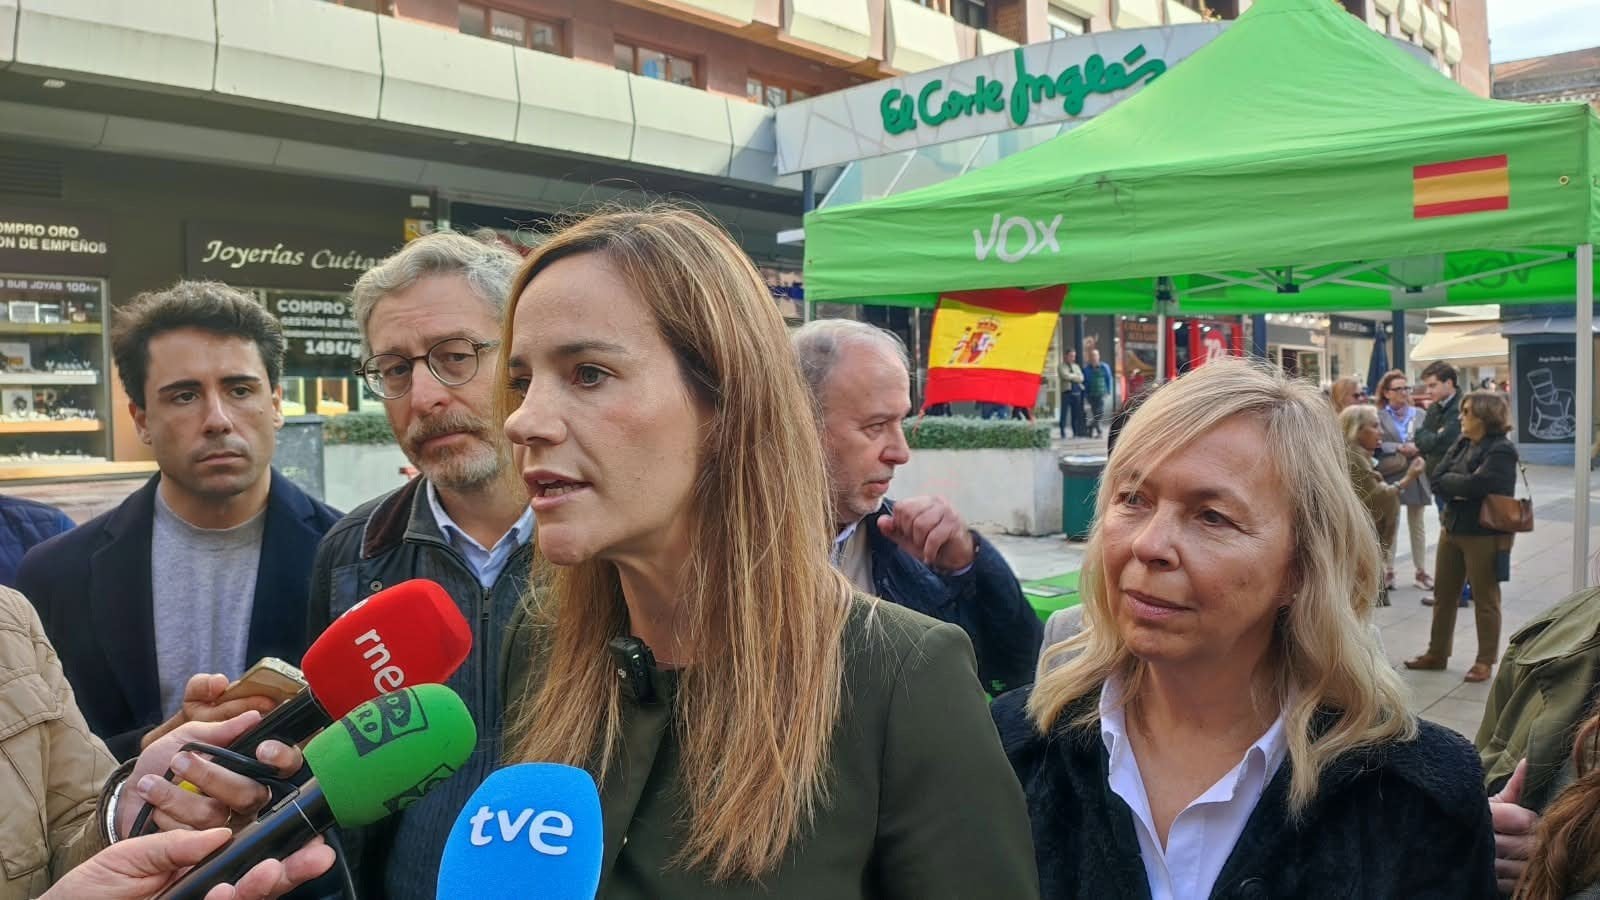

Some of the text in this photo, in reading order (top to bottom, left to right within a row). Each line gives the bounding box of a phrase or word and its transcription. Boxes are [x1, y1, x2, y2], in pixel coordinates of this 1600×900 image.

[880, 44, 1167, 135] El Corte Inglés
[0, 222, 79, 239] OMPRO ORO
[19, 237, 38, 250] DE
[41, 238, 107, 254] EMPEÑOS
[202, 239, 304, 269] Joyerías
[276, 299, 345, 315] COMPRO
[354, 628, 405, 695] rne
[470, 805, 574, 855] tve
